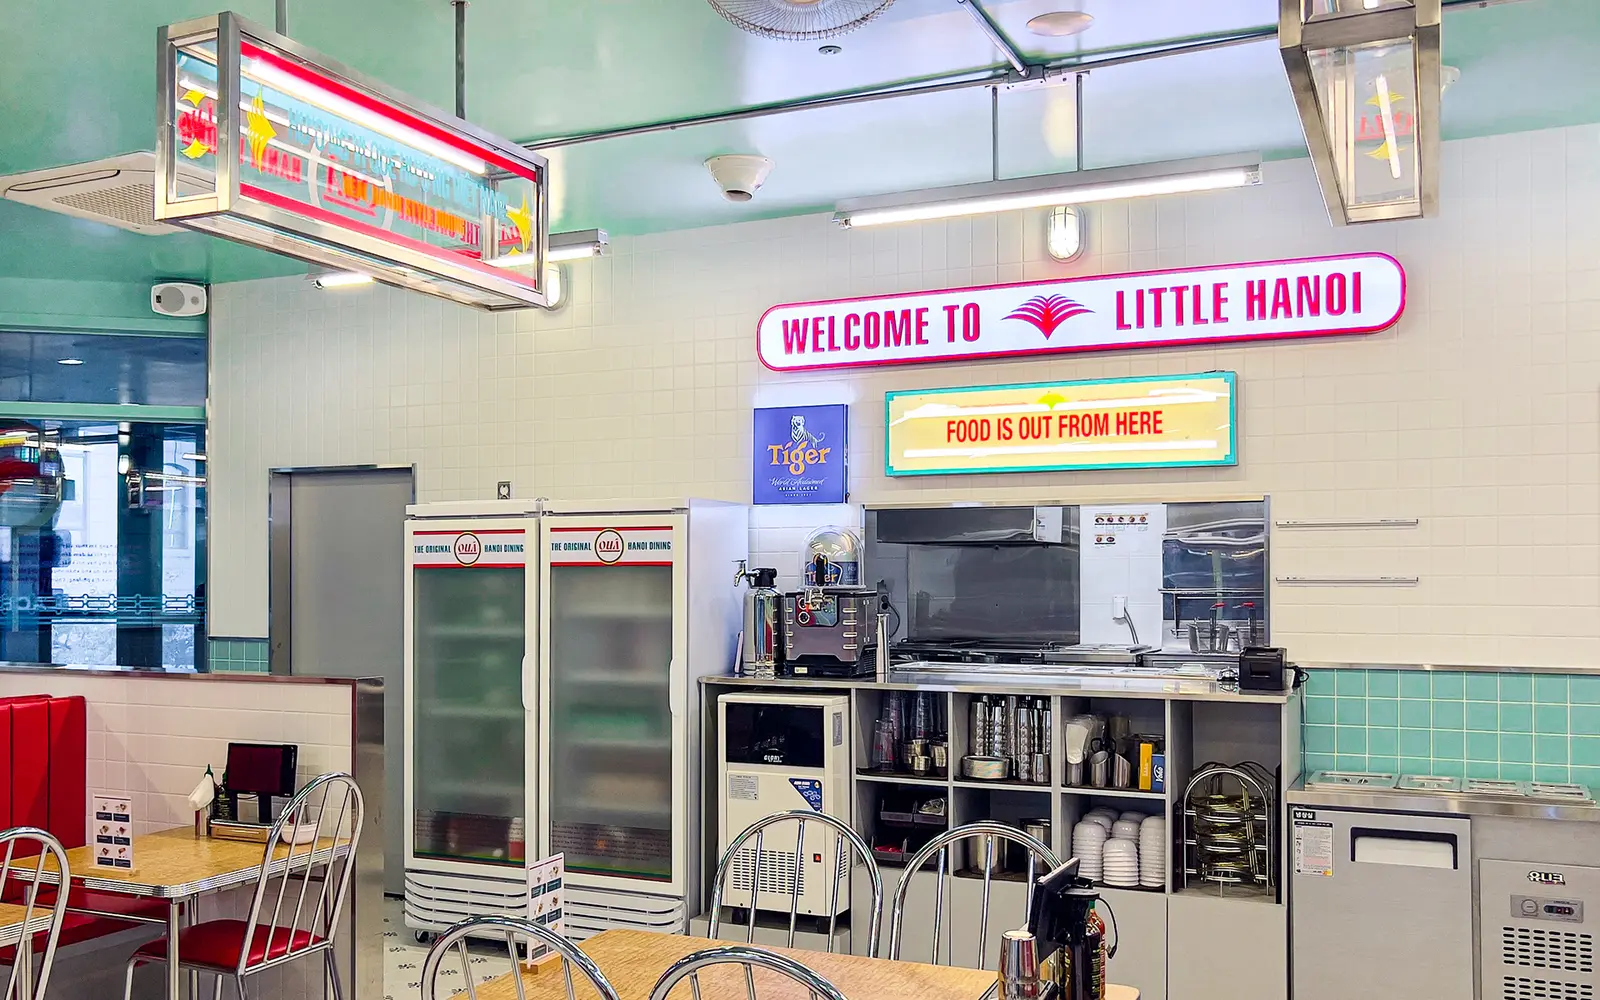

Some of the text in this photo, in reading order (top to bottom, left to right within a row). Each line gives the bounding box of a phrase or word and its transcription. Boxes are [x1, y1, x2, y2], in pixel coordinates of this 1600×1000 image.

[782, 271, 1362, 355] WELCOME TO LITTLE HANOI
[946, 410, 1163, 443] FOOD IS OUT FROM HERE
[767, 440, 831, 476] Tiger
[414, 545, 451, 554] THE ORIGINAL
[484, 544, 524, 553] HANOI DINING
[551, 541, 592, 551] THE ORIGINAL
[627, 541, 672, 550] HANOI DINING
[805, 571, 838, 582] Tier
